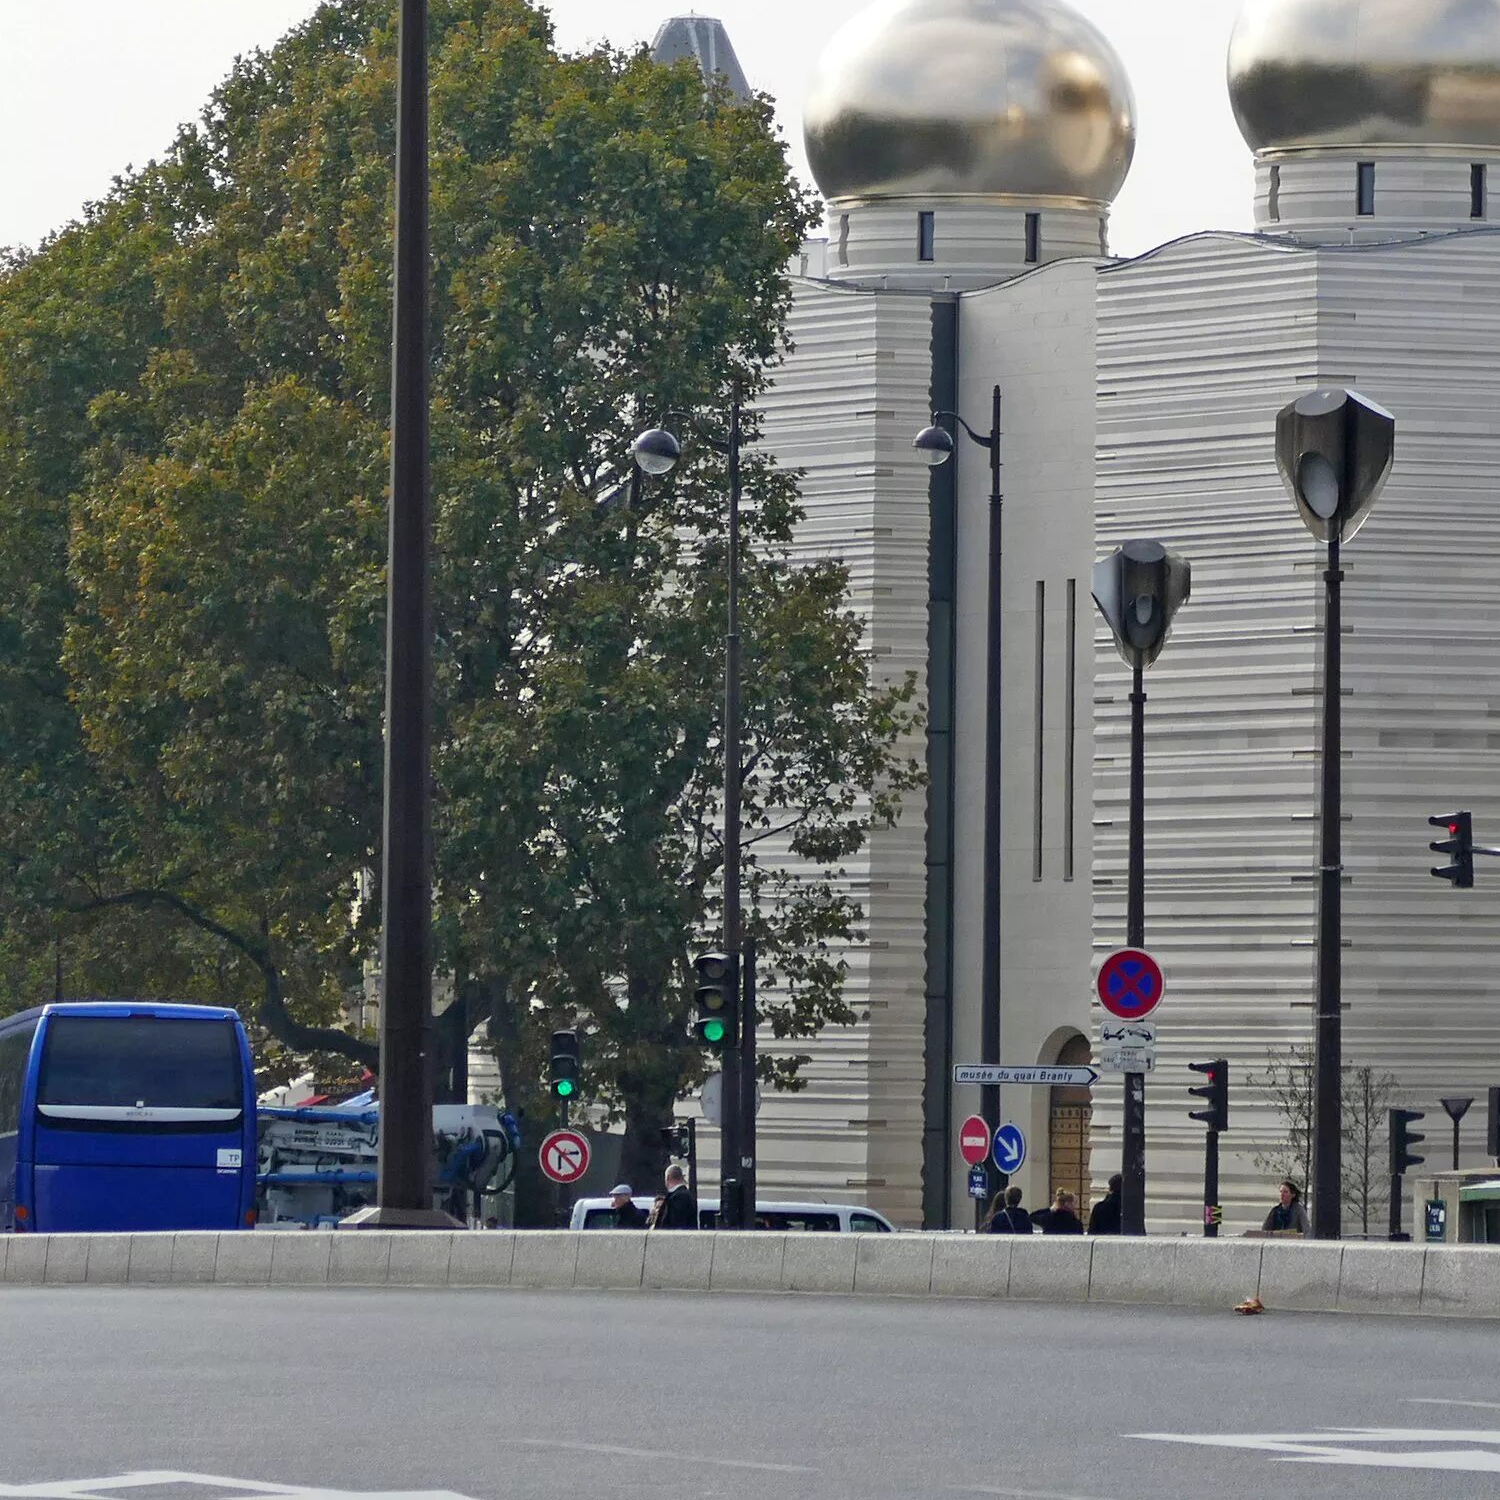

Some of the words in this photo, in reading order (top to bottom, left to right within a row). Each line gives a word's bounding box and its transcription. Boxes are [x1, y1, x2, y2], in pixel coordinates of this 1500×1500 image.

[960, 1070, 993, 1080] musée
[997, 1070, 1010, 1080] du
[1013, 1070, 1036, 1083] quai
[1039, 1070, 1074, 1082] Branly
